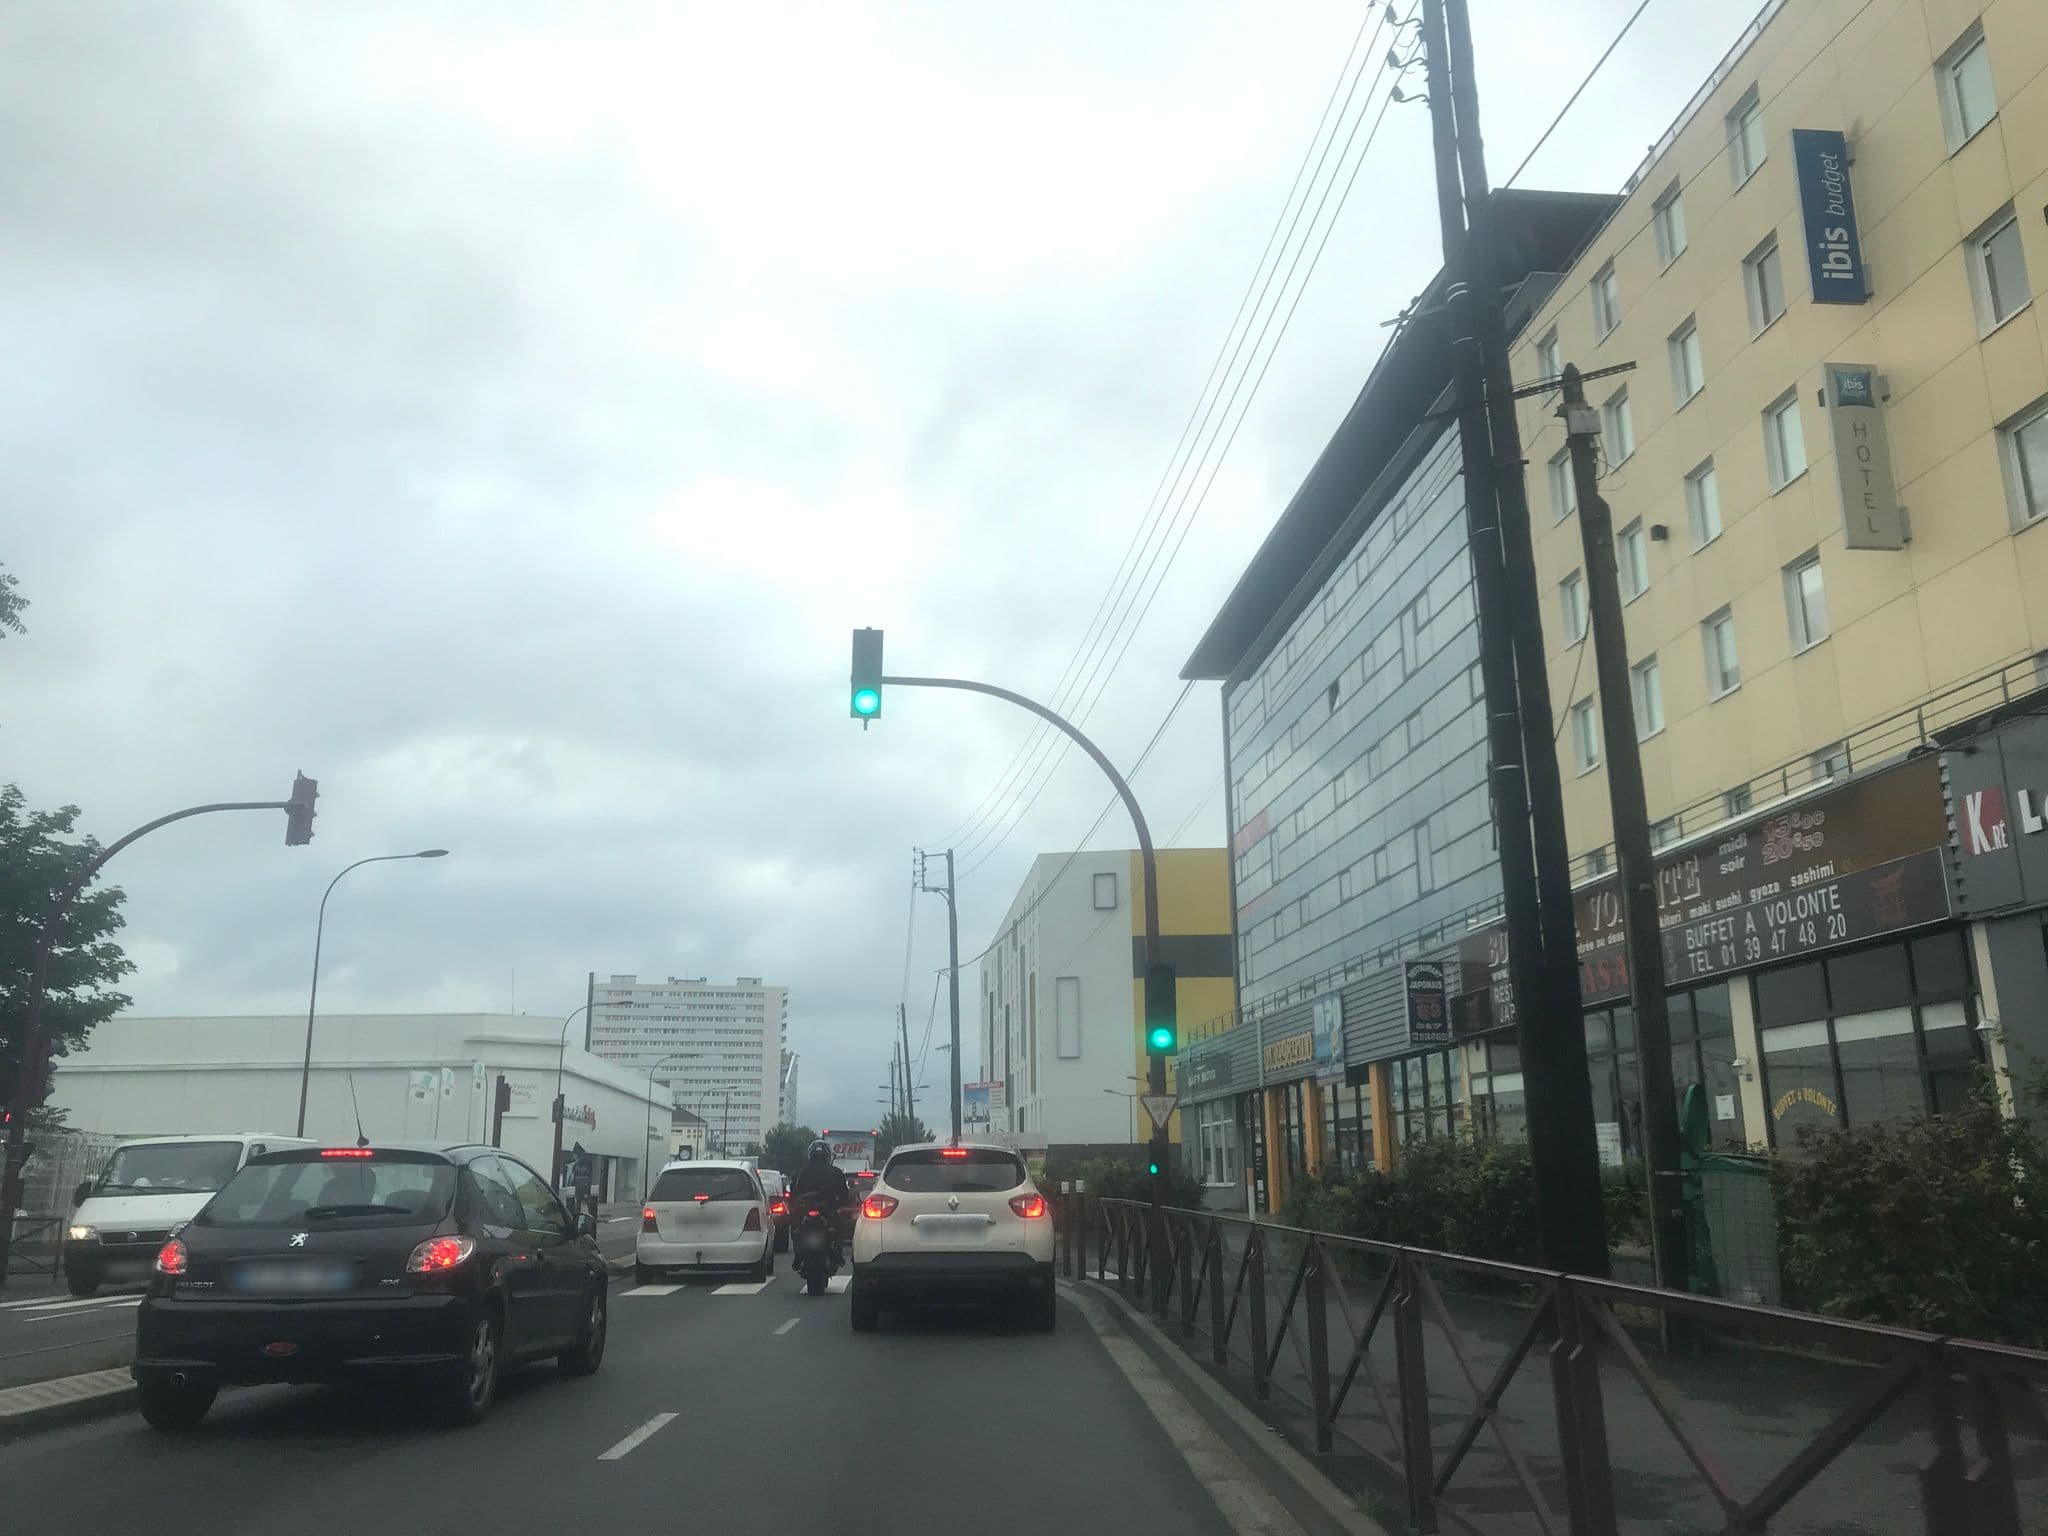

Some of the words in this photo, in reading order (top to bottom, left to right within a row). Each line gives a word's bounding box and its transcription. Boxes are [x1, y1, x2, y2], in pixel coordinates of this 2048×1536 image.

[1819, 151, 1846, 216] budget
[1818, 227, 1854, 279] ibis
[1843, 377, 1864, 390] ibis
[1852, 421, 1881, 534] HOTEL
[2017, 789, 2048, 834] L
[1718, 833, 1749, 856] midi
[1720, 856, 1746, 874] soir
[1689, 900, 1712, 918] maki
[1715, 890, 1742, 911] sushi
[1750, 881, 1780, 902] gyoza
[1791, 860, 1835, 887] sashimi
[1686, 916, 1735, 950] BUFFET
[1745, 911, 1757, 934] A
[1765, 884, 1840, 928] VOLONTE
[1688, 950, 1714, 975] TEL
[1721, 942, 1736, 966] 01
[1744, 937, 1760, 961] 39
[1771, 929, 1786, 953] 47
[1799, 921, 1817, 946] 48
[1828, 913, 1847, 940] 20
